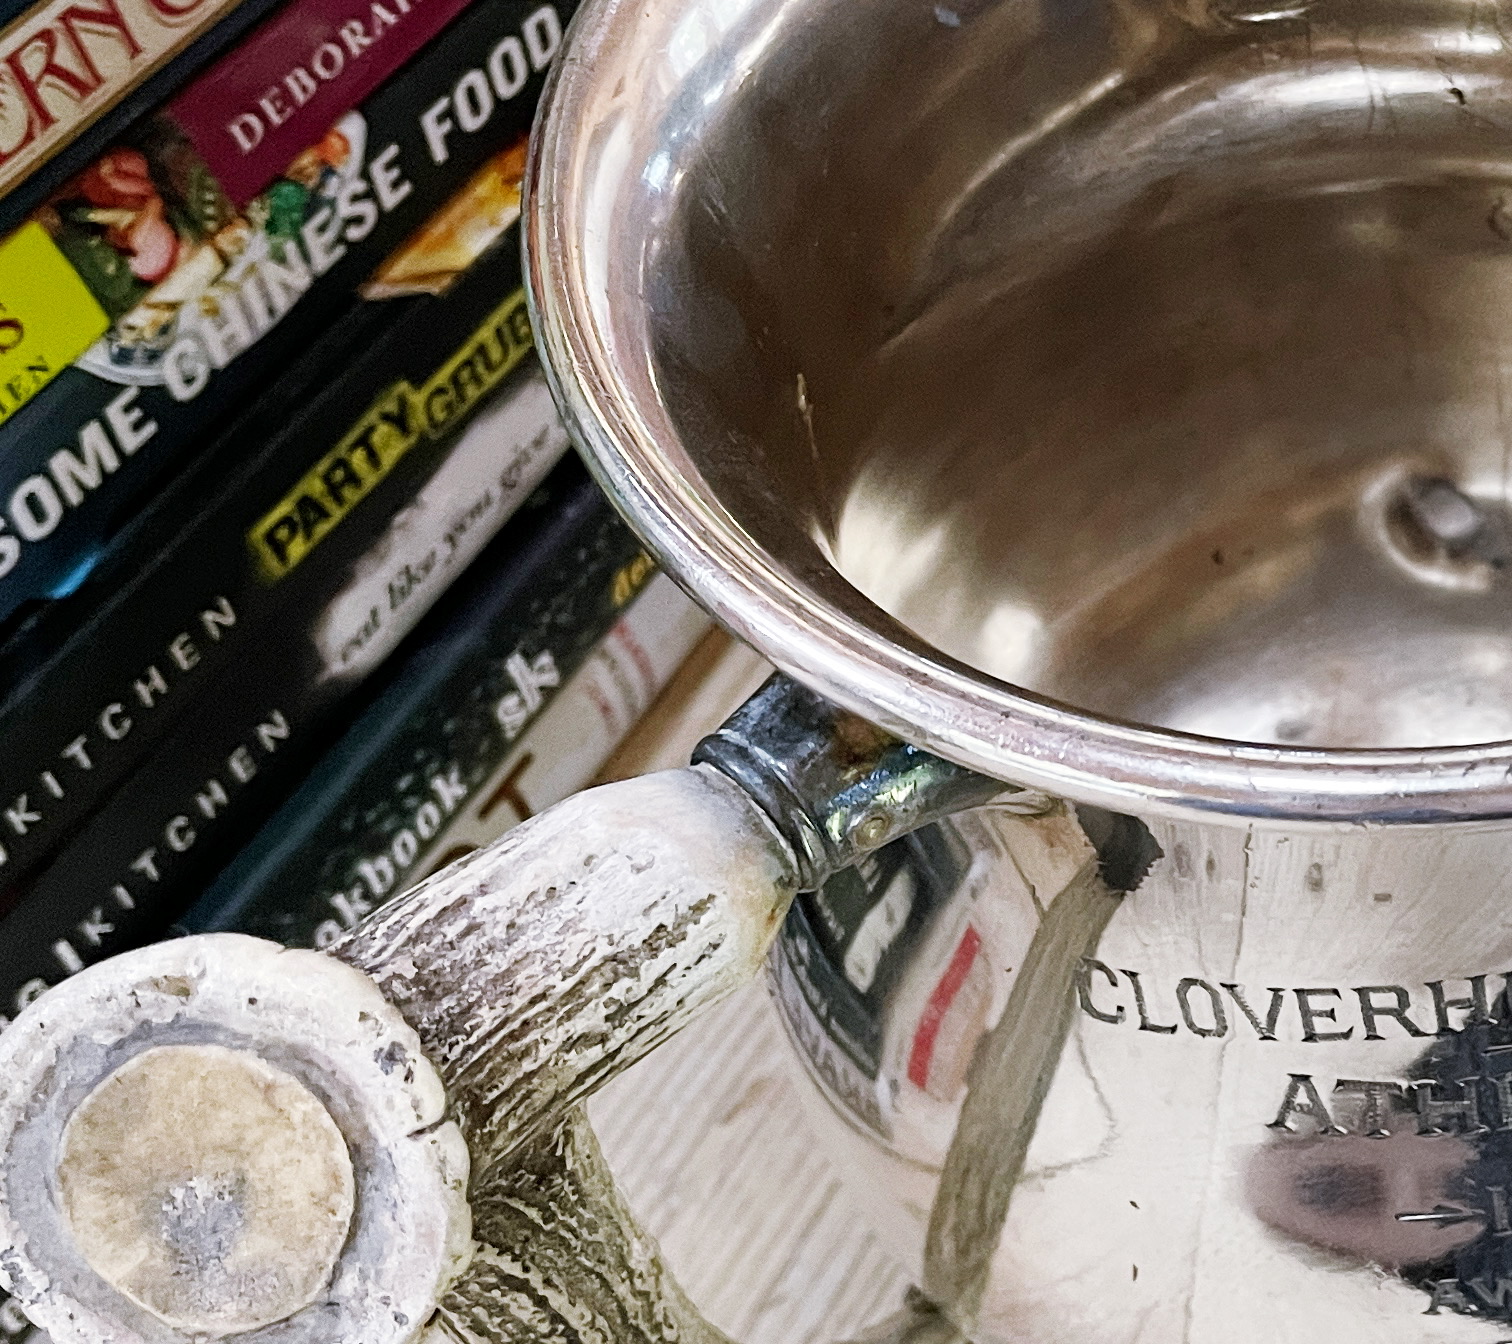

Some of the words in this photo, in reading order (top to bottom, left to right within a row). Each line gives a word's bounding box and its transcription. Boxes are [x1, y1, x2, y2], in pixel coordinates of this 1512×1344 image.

[161, 144, 413, 401] CHINESE
[420, 5, 563, 165] FOOD
[264, 386, 415, 566] PARTY
[4, 594, 238, 835] KITCHEN
[79, 709, 291, 946] KITCHEN
